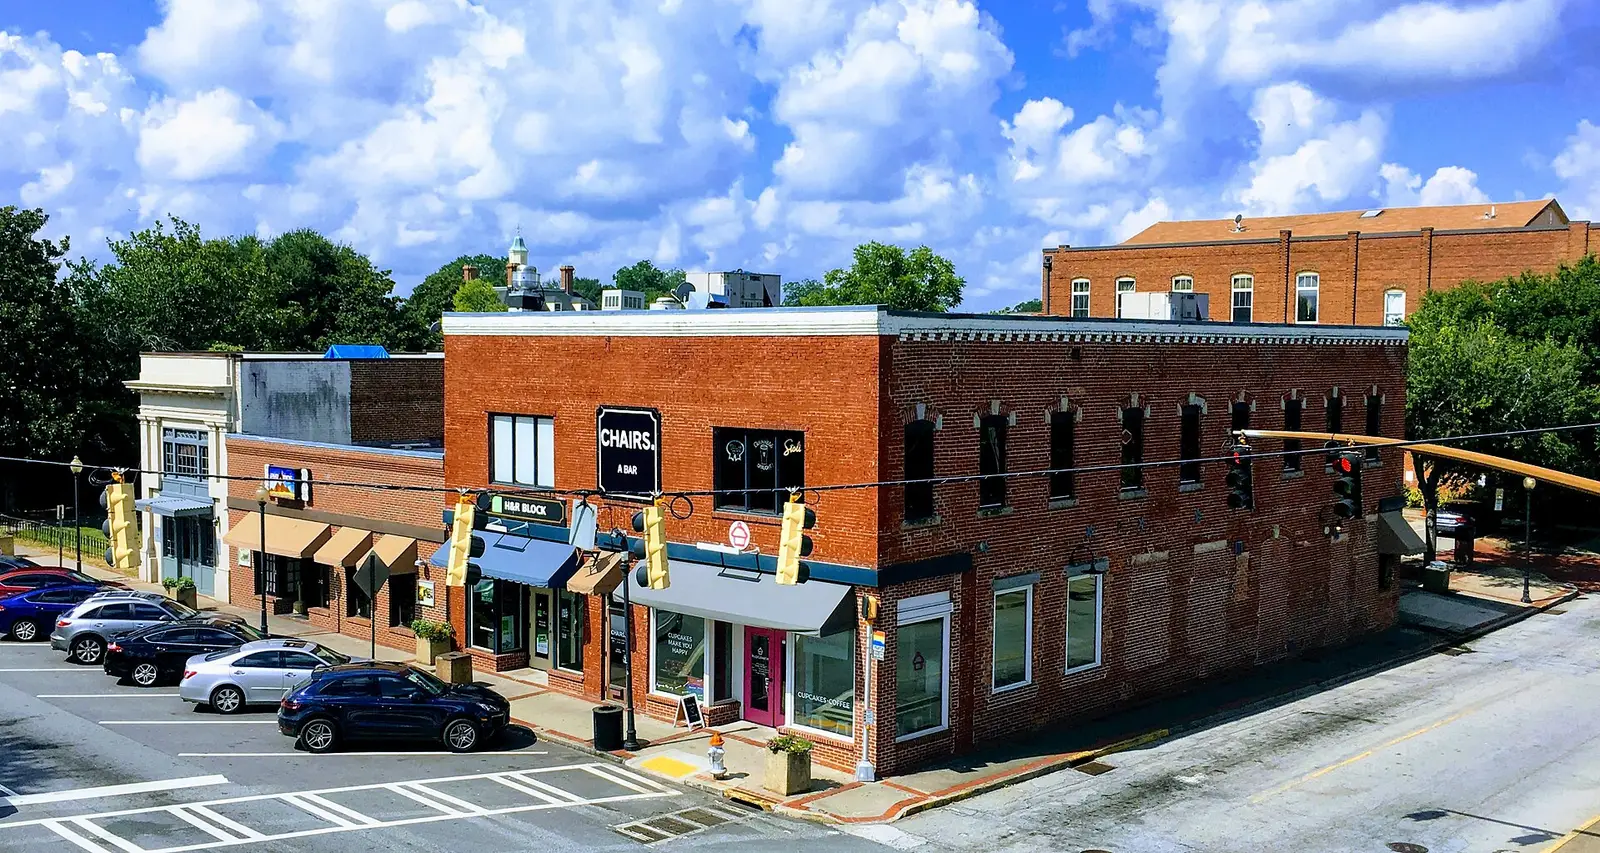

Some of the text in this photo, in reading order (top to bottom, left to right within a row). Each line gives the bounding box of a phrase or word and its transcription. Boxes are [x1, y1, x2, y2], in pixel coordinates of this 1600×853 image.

[601, 428, 655, 451] CHAIRS.
[617, 464, 638, 475] A BAR
[504, 501, 547, 516] H&R BLOCK
[668, 632, 693, 642] CUPCAKES
[668, 640, 682, 648] MAKE
[672, 647, 688, 655] HAPPY
[797, 691, 850, 709] CUPCAKES COFFEE
